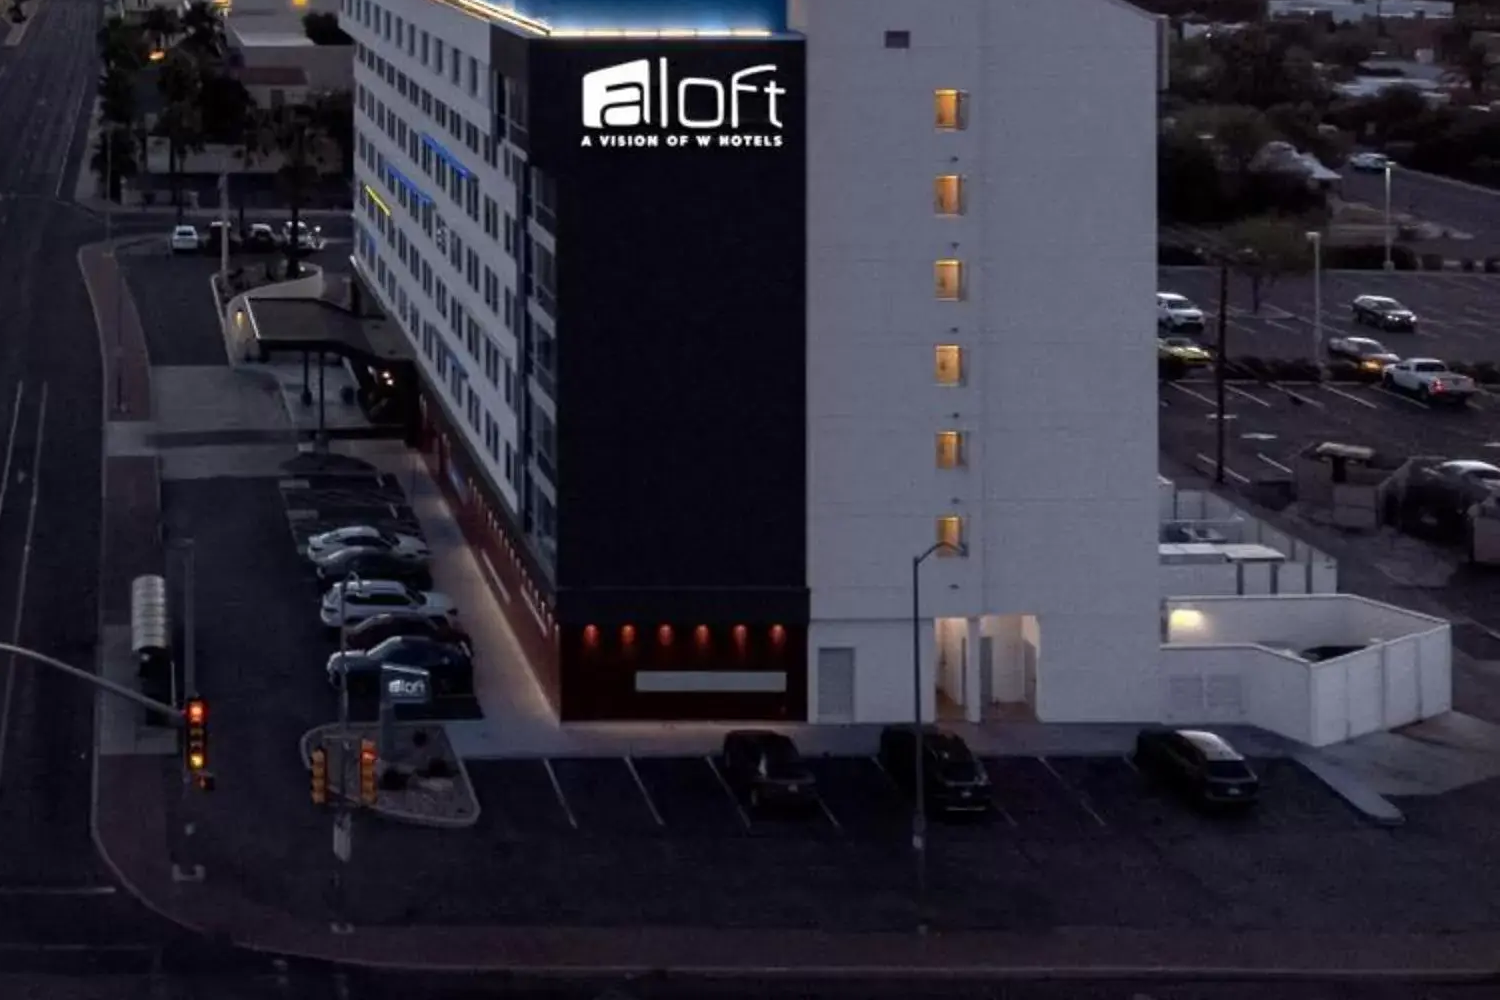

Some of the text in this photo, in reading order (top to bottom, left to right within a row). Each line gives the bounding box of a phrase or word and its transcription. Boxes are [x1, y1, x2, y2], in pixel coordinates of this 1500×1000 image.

[582, 56, 786, 129] aloft
[580, 134, 783, 147] A VISION OF W HOTELS
